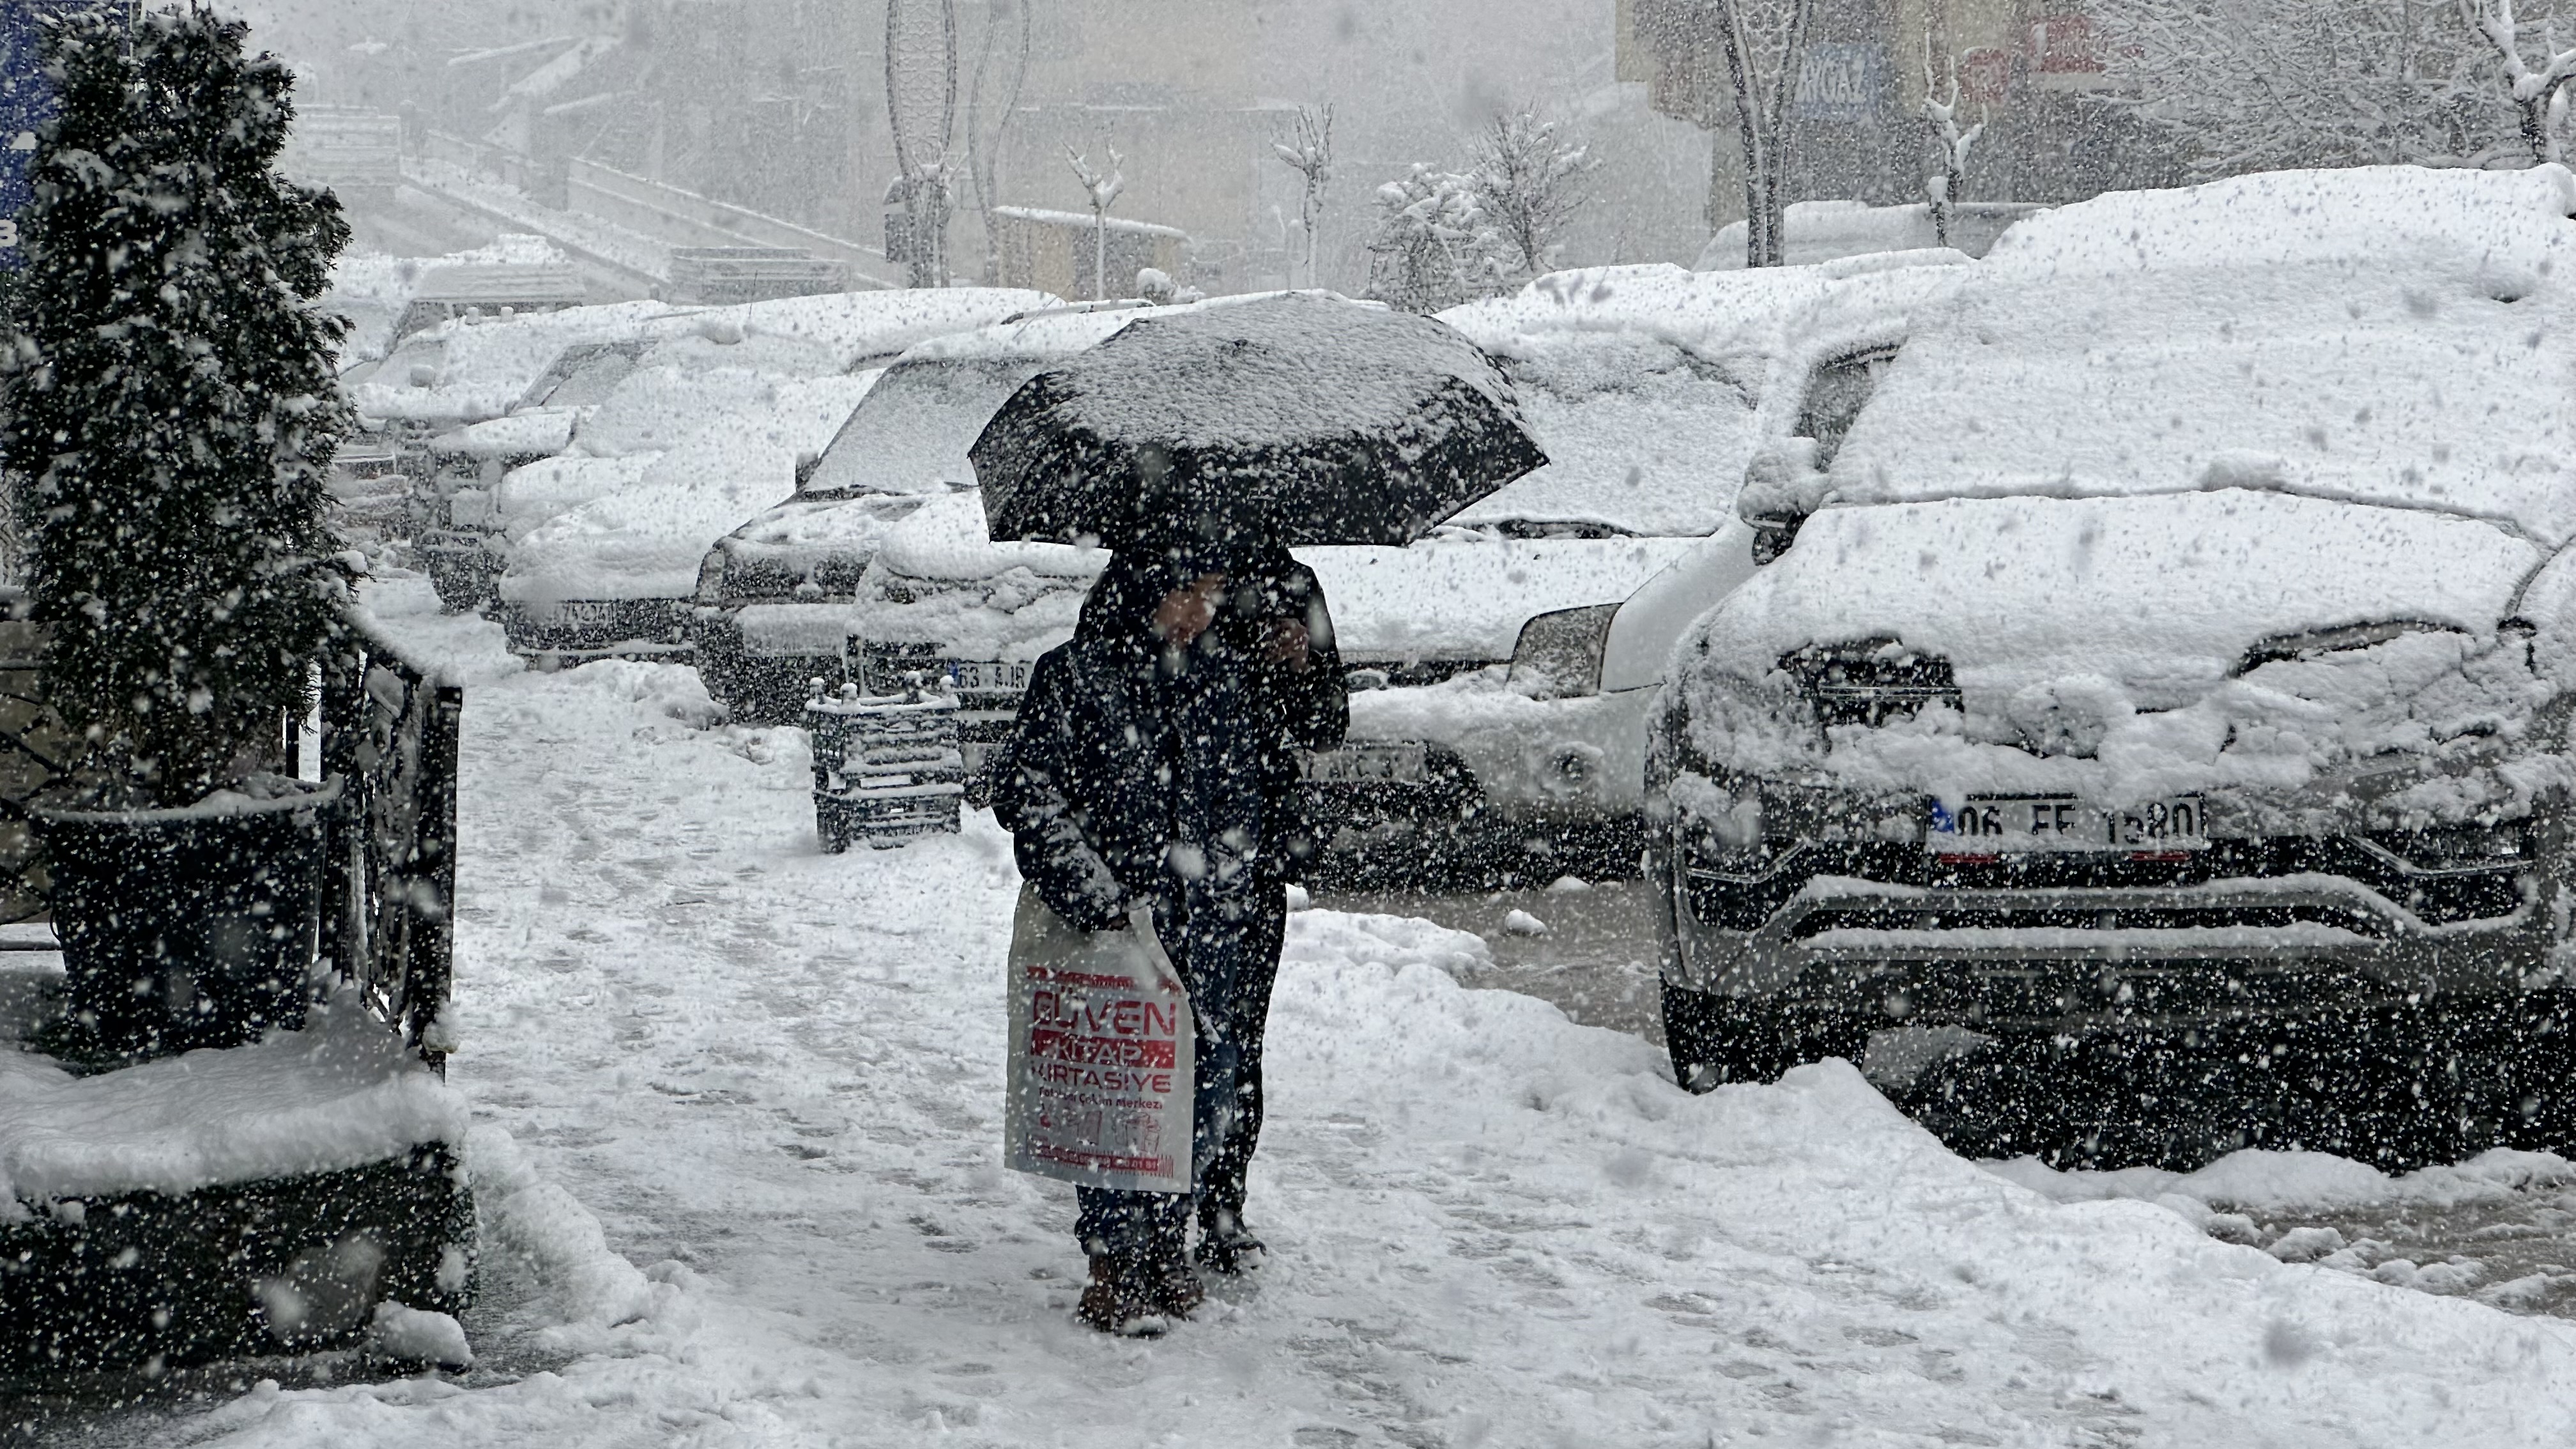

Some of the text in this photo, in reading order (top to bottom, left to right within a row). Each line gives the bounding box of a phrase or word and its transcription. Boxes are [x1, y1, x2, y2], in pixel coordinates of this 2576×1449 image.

[958, 666, 979, 689] 63
[1958, 806, 2003, 837] 06
[1034, 986, 1176, 1036] GÜVEN
